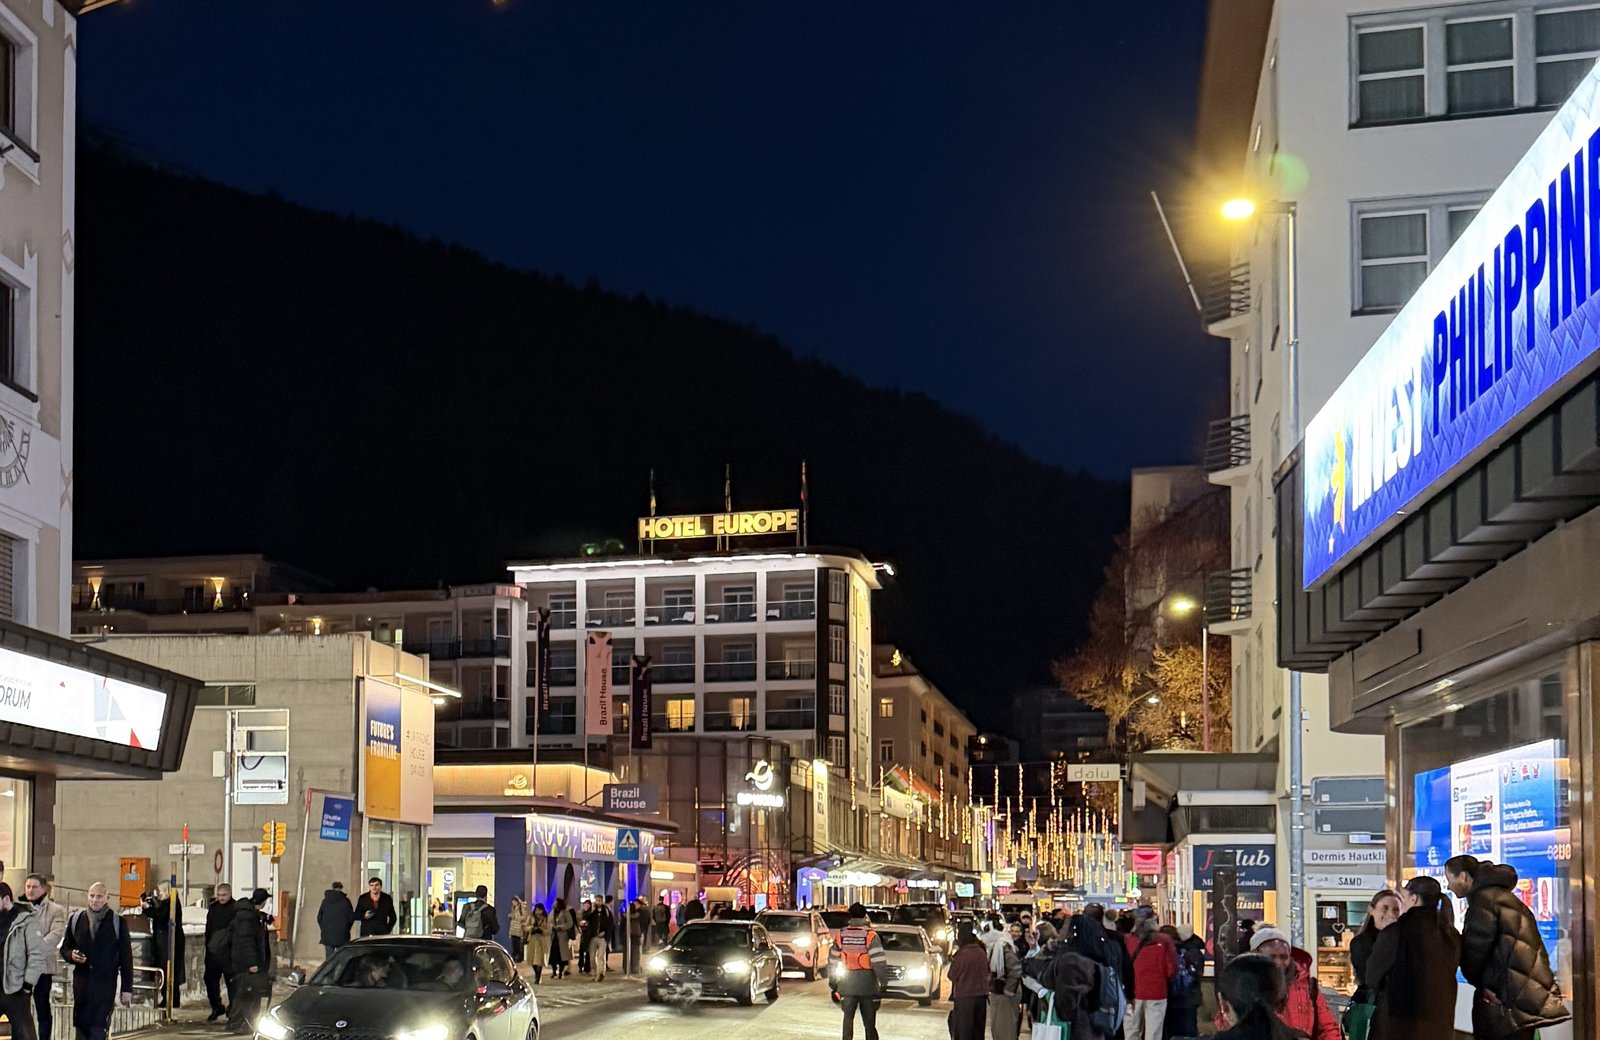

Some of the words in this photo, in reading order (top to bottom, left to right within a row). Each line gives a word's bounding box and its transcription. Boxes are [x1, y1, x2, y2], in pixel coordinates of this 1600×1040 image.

[1352, 338, 1424, 512] INVEST
[639, 516, 706, 539] HOTEL
[712, 511, 798, 535] EUROPE
[599, 668, 608, 698] House
[599, 700, 608, 726] Brazil
[370, 719, 395, 741] FUTURE'S
[640, 716, 648, 742] Brazil
[370, 739, 398, 761] FRONTLINE
[1074, 767, 1110, 779] dalu
[610, 787, 640, 798] Brazil
[610, 799, 646, 809] House
[581, 831, 598, 854] Brazil
[598, 833, 616, 856] House
[1311, 851, 1346, 861] Dermis
[1348, 851, 1385, 861] Hautkli
[1236, 879, 1268, 887] Leaders
[1236, 902, 1264, 910] LEADERS
